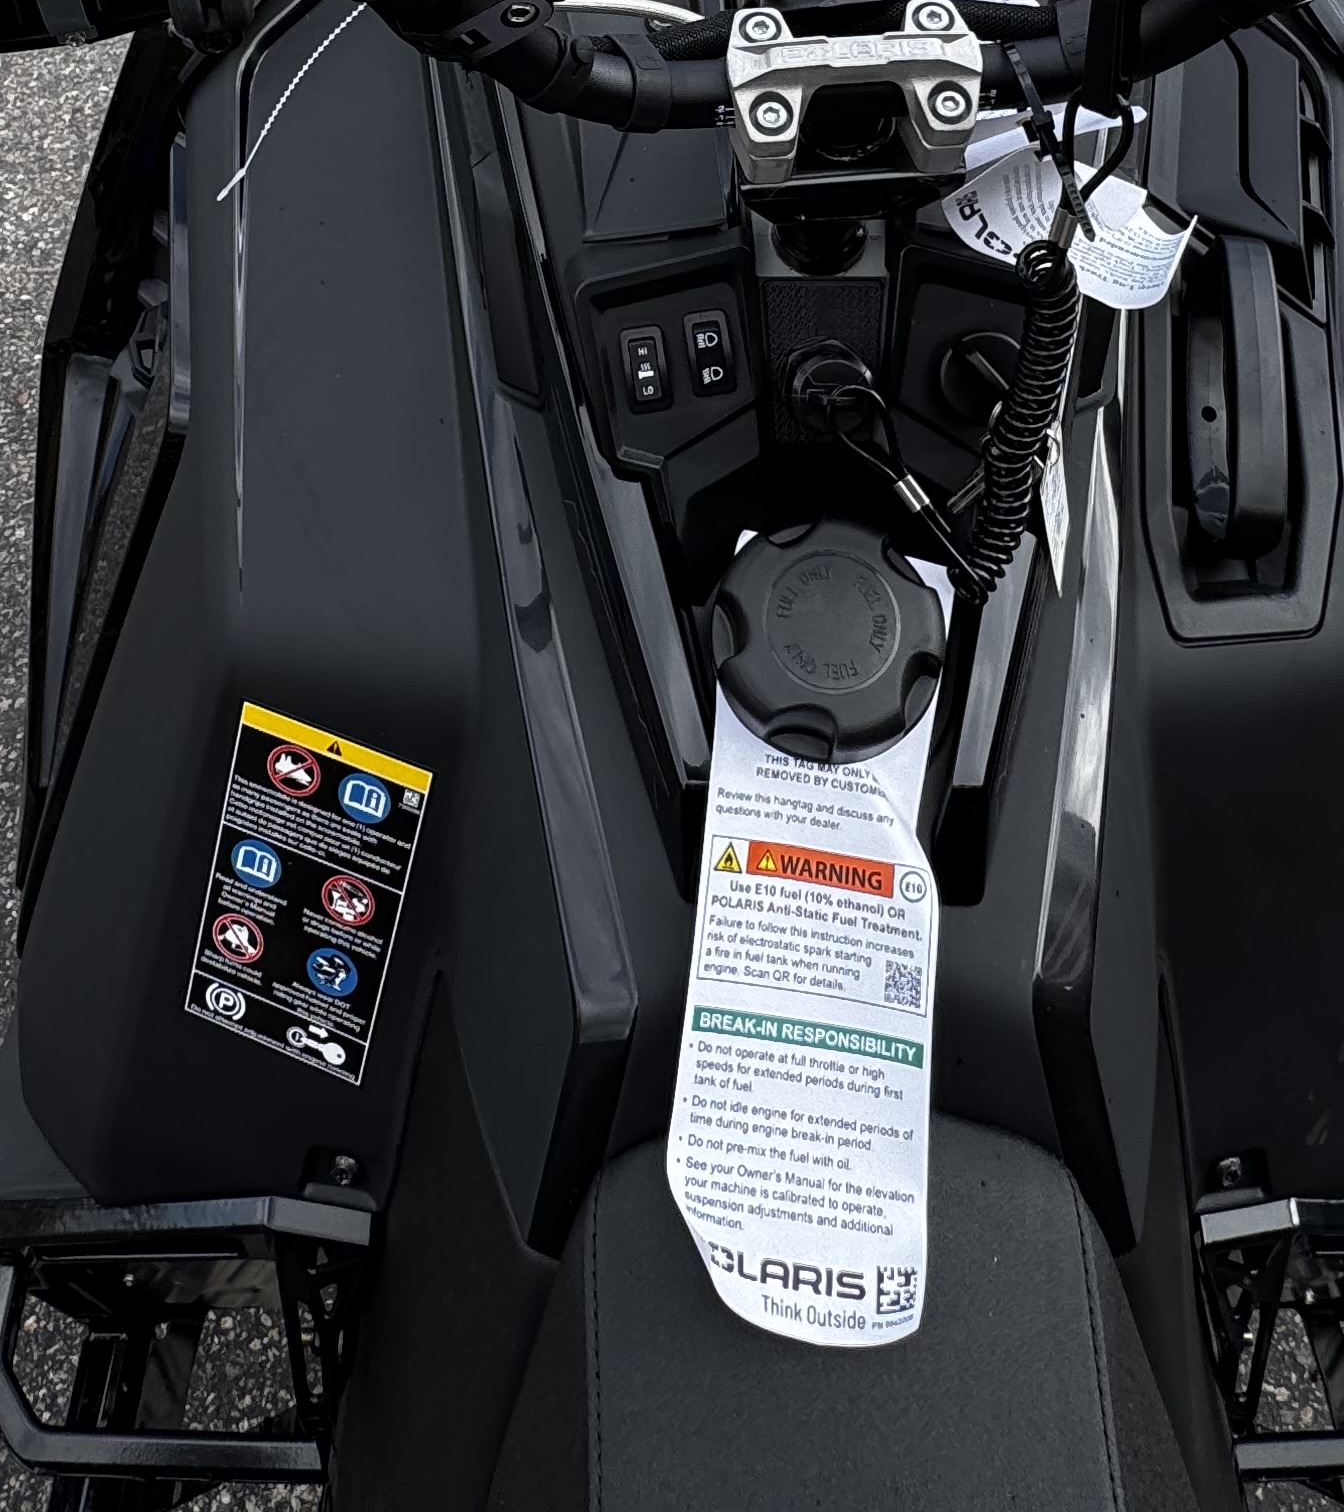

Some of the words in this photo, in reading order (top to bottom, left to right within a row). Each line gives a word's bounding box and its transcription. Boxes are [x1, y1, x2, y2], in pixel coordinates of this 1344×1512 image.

[781, 40, 929, 64] POLARIS
[638, 347, 648, 356] HI
[642, 386, 654, 396] LO
[776, 587, 798, 618] FUEL
[799, 565, 830, 586] ONLY
[869, 615, 889, 653] ONLY
[822, 660, 859, 681] FUEL
[756, 767, 810, 784] REMOVED
[814, 775, 828, 787] BY
[765, 753, 789, 766] THIS
[842, 766, 870, 779] ONLY
[716, 804, 761, 818] questions
[764, 810, 783, 820] with
[786, 813, 807, 824] your
[717, 788, 753, 802] Review
[755, 793, 771, 804] this
[774, 795, 813, 813] hangtag
[816, 803, 834, 815] and
[837, 806, 874, 821] discuss
[877, 814, 894, 827] any
[780, 855, 883, 891] WARNING
[906, 884, 923, 894] E10
[730, 880, 751, 893] Use
[756, 883, 776, 897] E10
[780, 886, 801, 900] fuel
[806, 891, 833, 907] (10%
[836, 898, 884, 918] ethanol)
[887, 906, 906, 921] OR
[711, 895, 764, 912] POLARIS
[767, 902, 828, 922] Anti-Static
[832, 913, 857, 927] Fuel
[861, 917, 923, 942] Treatment.
[707, 932, 725, 943] risk
[727, 933, 738, 943] of
[740, 936, 800, 952] electrostatic
[804, 944, 831, 958] spark
[834, 950, 872, 967] starting
[709, 915, 743, 929] Failure
[745, 920, 755, 930] to
[758, 922, 788, 935] follow
[790, 926, 808, 938] this
[811, 929, 863, 948] instruction
[866, 939, 915, 959] increases
[705, 947, 711, 956] a
[715, 947, 730, 957] fire
[734, 949, 742, 959] in
[745, 950, 764, 963] fuel
[767, 955, 788, 966] tank
[792, 957, 819, 971] when
[822, 963, 861, 981] running
[743, 965, 770, 979] Scan
[773, 971, 790, 982] QR
[793, 972, 807, 984] for
[700, 1012, 778, 1038] BREAK-IN
[782, 1023, 917, 1062] RESPONSIBILITY
[698, 1040, 713, 1053] Do
[715, 1044, 733, 1056] not
[735, 1048, 775, 1065] operate
[778, 1053, 788, 1064] at
[791, 1053, 806, 1066] full
[809, 1058, 845, 1073] throttle
[848, 1064, 859, 1074] or
[862, 1066, 885, 1082] high
[694, 1074, 716, 1087] tank
[719, 1077, 731, 1089] of
[696, 1058, 734, 1073] speeds
[737, 1061, 750, 1075] for
[753, 1066, 802, 1083] extended
[806, 1074, 845, 1089] periods
[847, 1079, 881, 1098] during
[884, 1085, 904, 1101] first
[690, 1112, 713, 1126] time
[715, 1116, 749, 1134] during
[752, 1122, 788, 1138] engine
[792, 1127, 835, 1145] break-in
[692, 1094, 707, 1108] Do
[710, 1100, 727, 1111] not
[730, 1101, 749, 1114] idle
[751, 1105, 787, 1122] engine
[790, 1109, 805, 1122] for
[808, 1113, 857, 1132] extended
[860, 1122, 900, 1139] periods
[903, 1128, 914, 1141] of
[688, 1133, 703, 1147] Do
[706, 1138, 724, 1151] not
[726, 1141, 766, 1157] pre-mix
[769, 1145, 787, 1160] the
[790, 1149, 810, 1165] fuel
[812, 1152, 833, 1168] with
[684, 1175, 708, 1188] your
[711, 1180, 757, 1197] machine
[760, 1185, 769, 1199] is
[772, 1189, 825, 1208] calibrated
[828, 1196, 839, 1210] to
[685, 1156, 708, 1171] See
[710, 1163, 735, 1176] your
[737, 1165, 782, 1184] Owner's
[785, 1171, 825, 1189] Manual
[828, 1178, 842, 1192] for
[845, 1182, 862, 1196] the
[865, 1185, 915, 1204] elevation
[747, 1202, 814, 1225] adjustments
[817, 1214, 838, 1228] and
[840, 1215, 894, 1236] additional
[708, 1241, 867, 1300] OLARIS
[761, 1293, 803, 1322] Think
[807, 1304, 866, 1330] Outside
